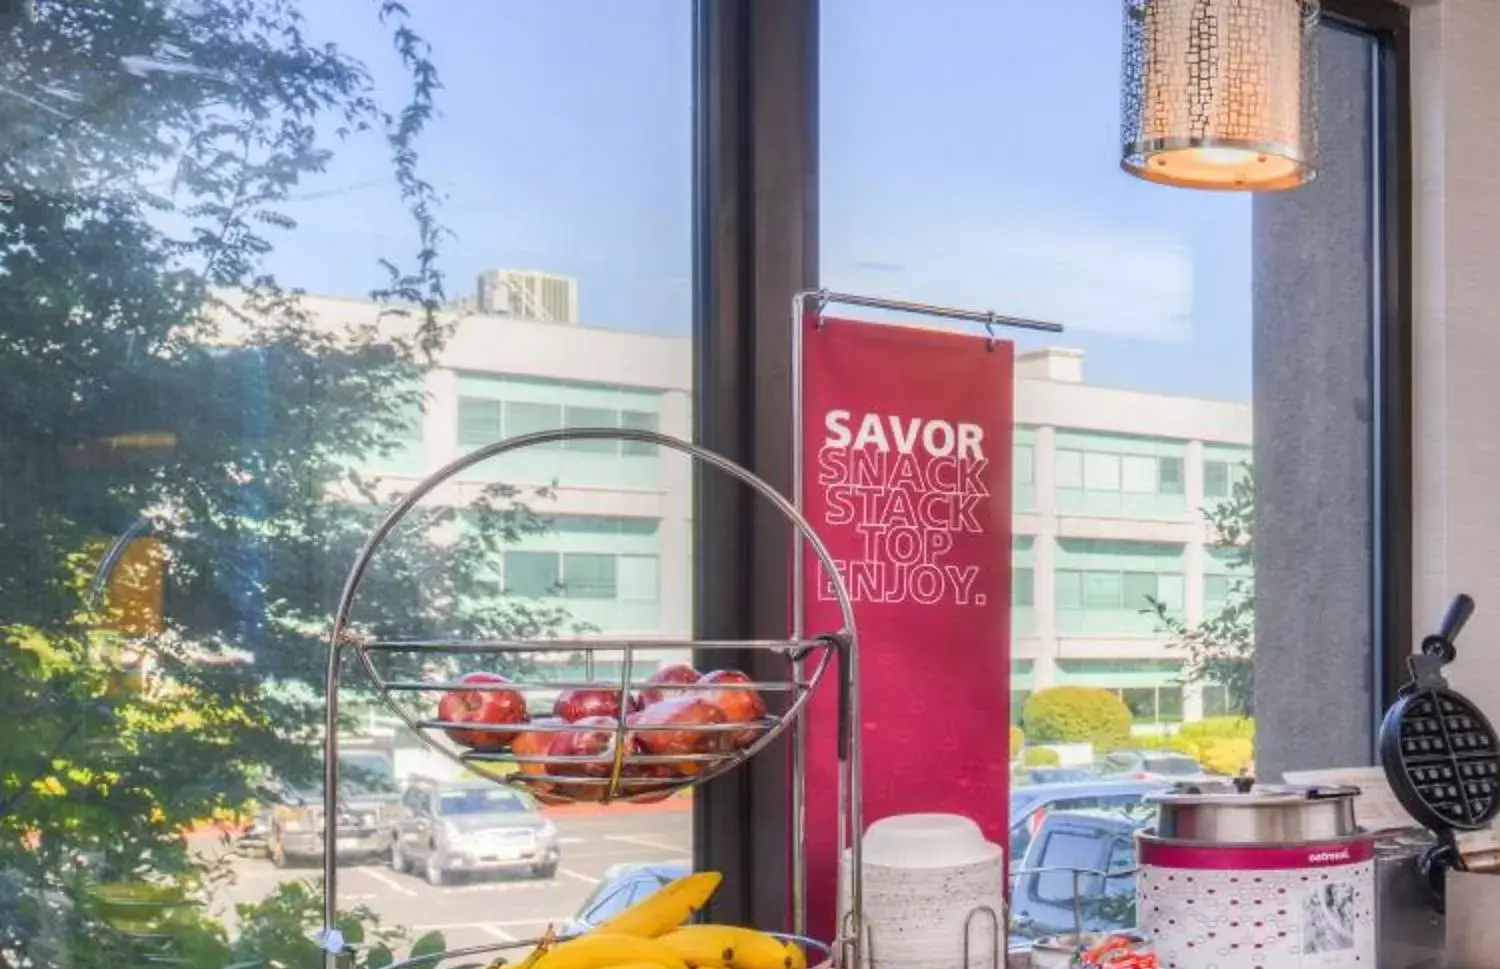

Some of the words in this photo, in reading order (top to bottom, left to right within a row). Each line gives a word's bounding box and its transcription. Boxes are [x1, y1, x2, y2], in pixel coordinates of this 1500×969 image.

[824, 409, 985, 461] SAVOR
[818, 446, 990, 497] SNACK
[825, 484, 984, 533] STACK
[856, 522, 953, 566] TOP
[817, 558, 987, 606] ENJOY.
